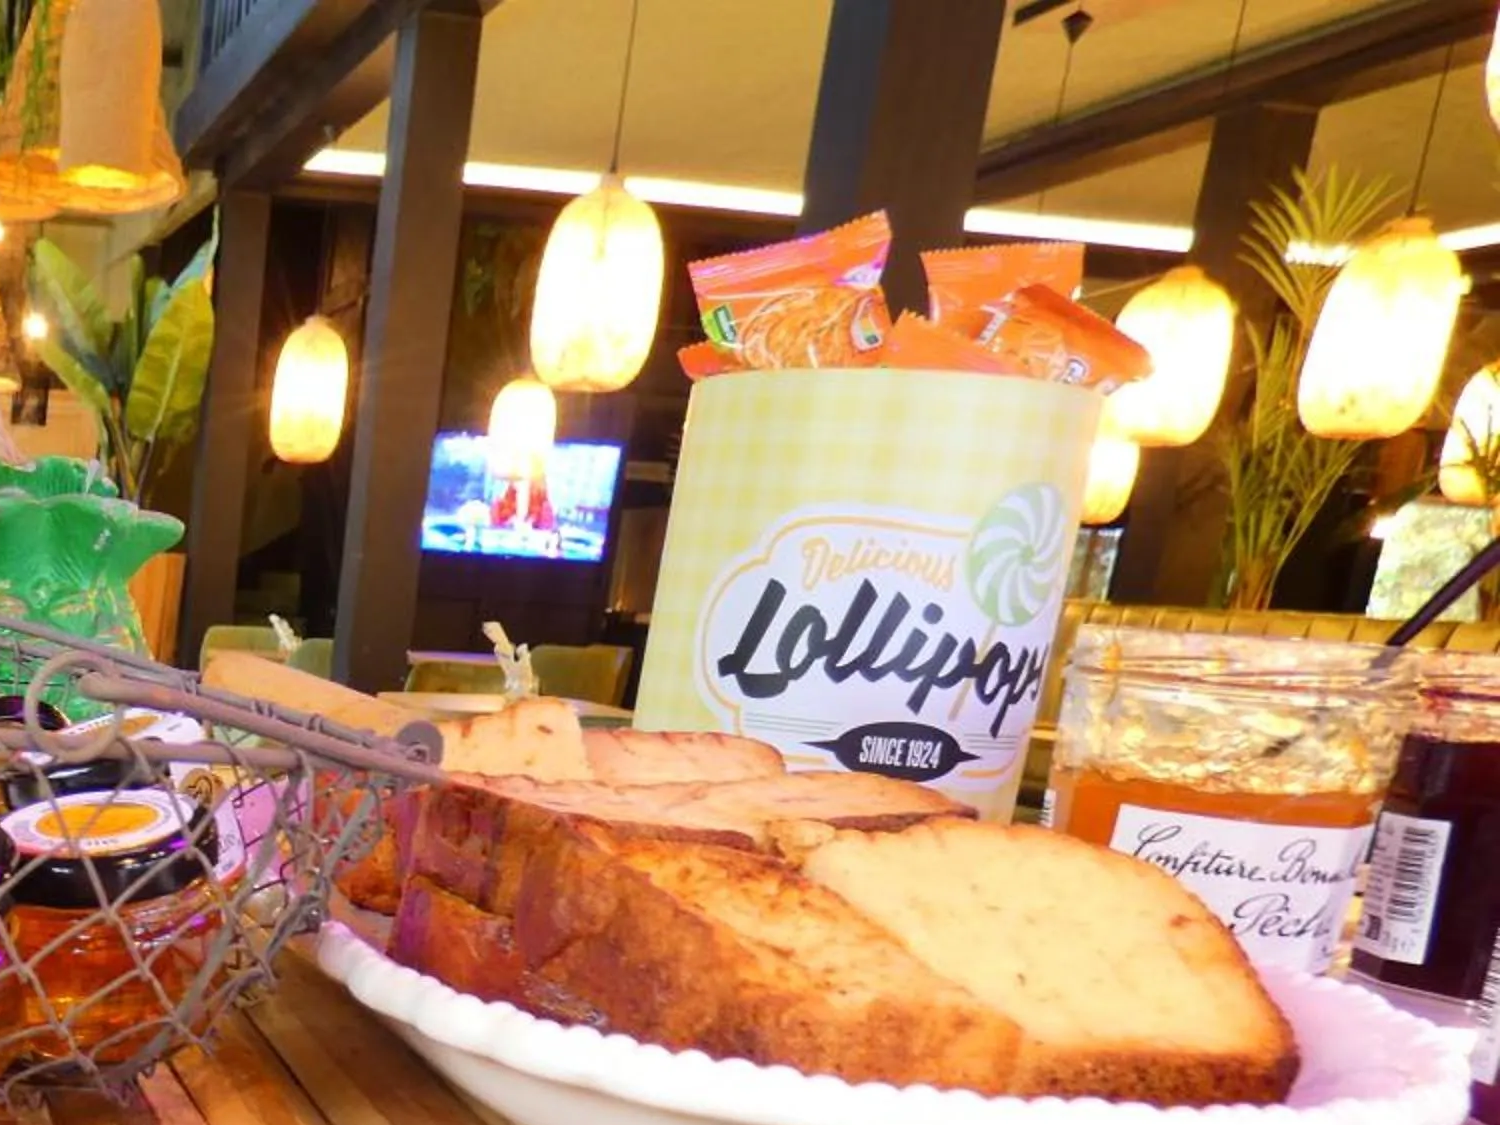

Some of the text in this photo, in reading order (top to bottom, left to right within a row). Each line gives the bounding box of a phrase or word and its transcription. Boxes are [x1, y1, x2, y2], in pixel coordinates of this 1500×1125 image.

[802, 536, 957, 592] Delicious
[859, 735, 942, 769] SINCE 1924
